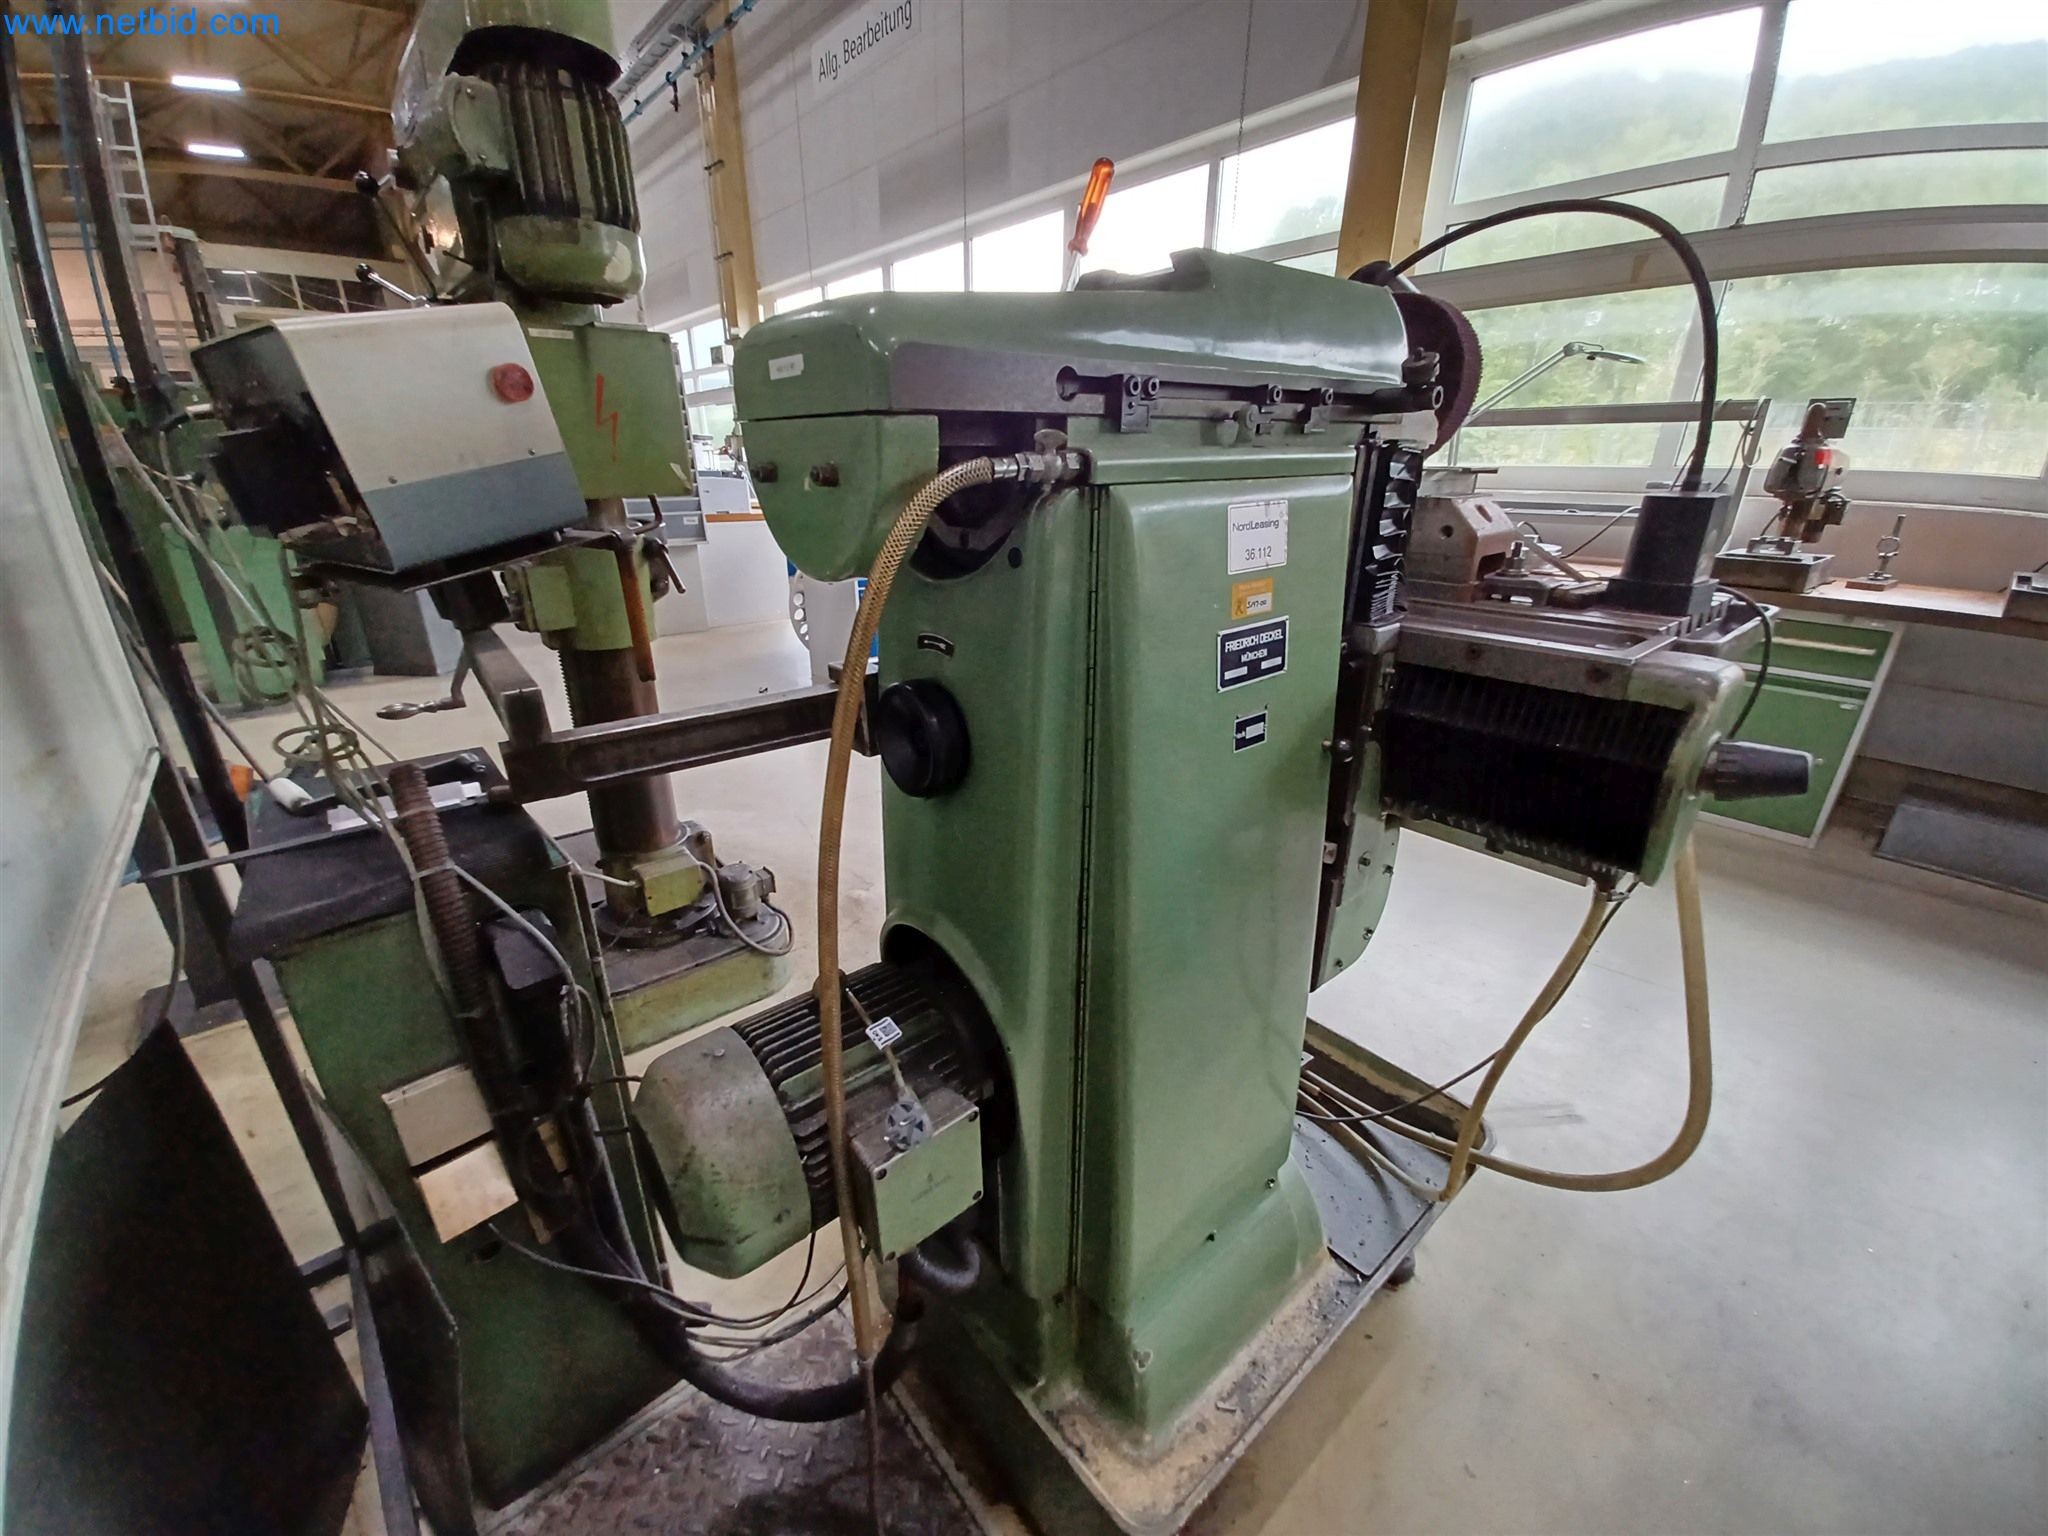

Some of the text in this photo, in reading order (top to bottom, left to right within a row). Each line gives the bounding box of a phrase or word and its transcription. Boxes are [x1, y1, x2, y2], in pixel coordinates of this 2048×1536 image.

[818, 0, 913, 83] Allg. Bearbeitung
[1232, 519, 1280, 532] NordLeasing
